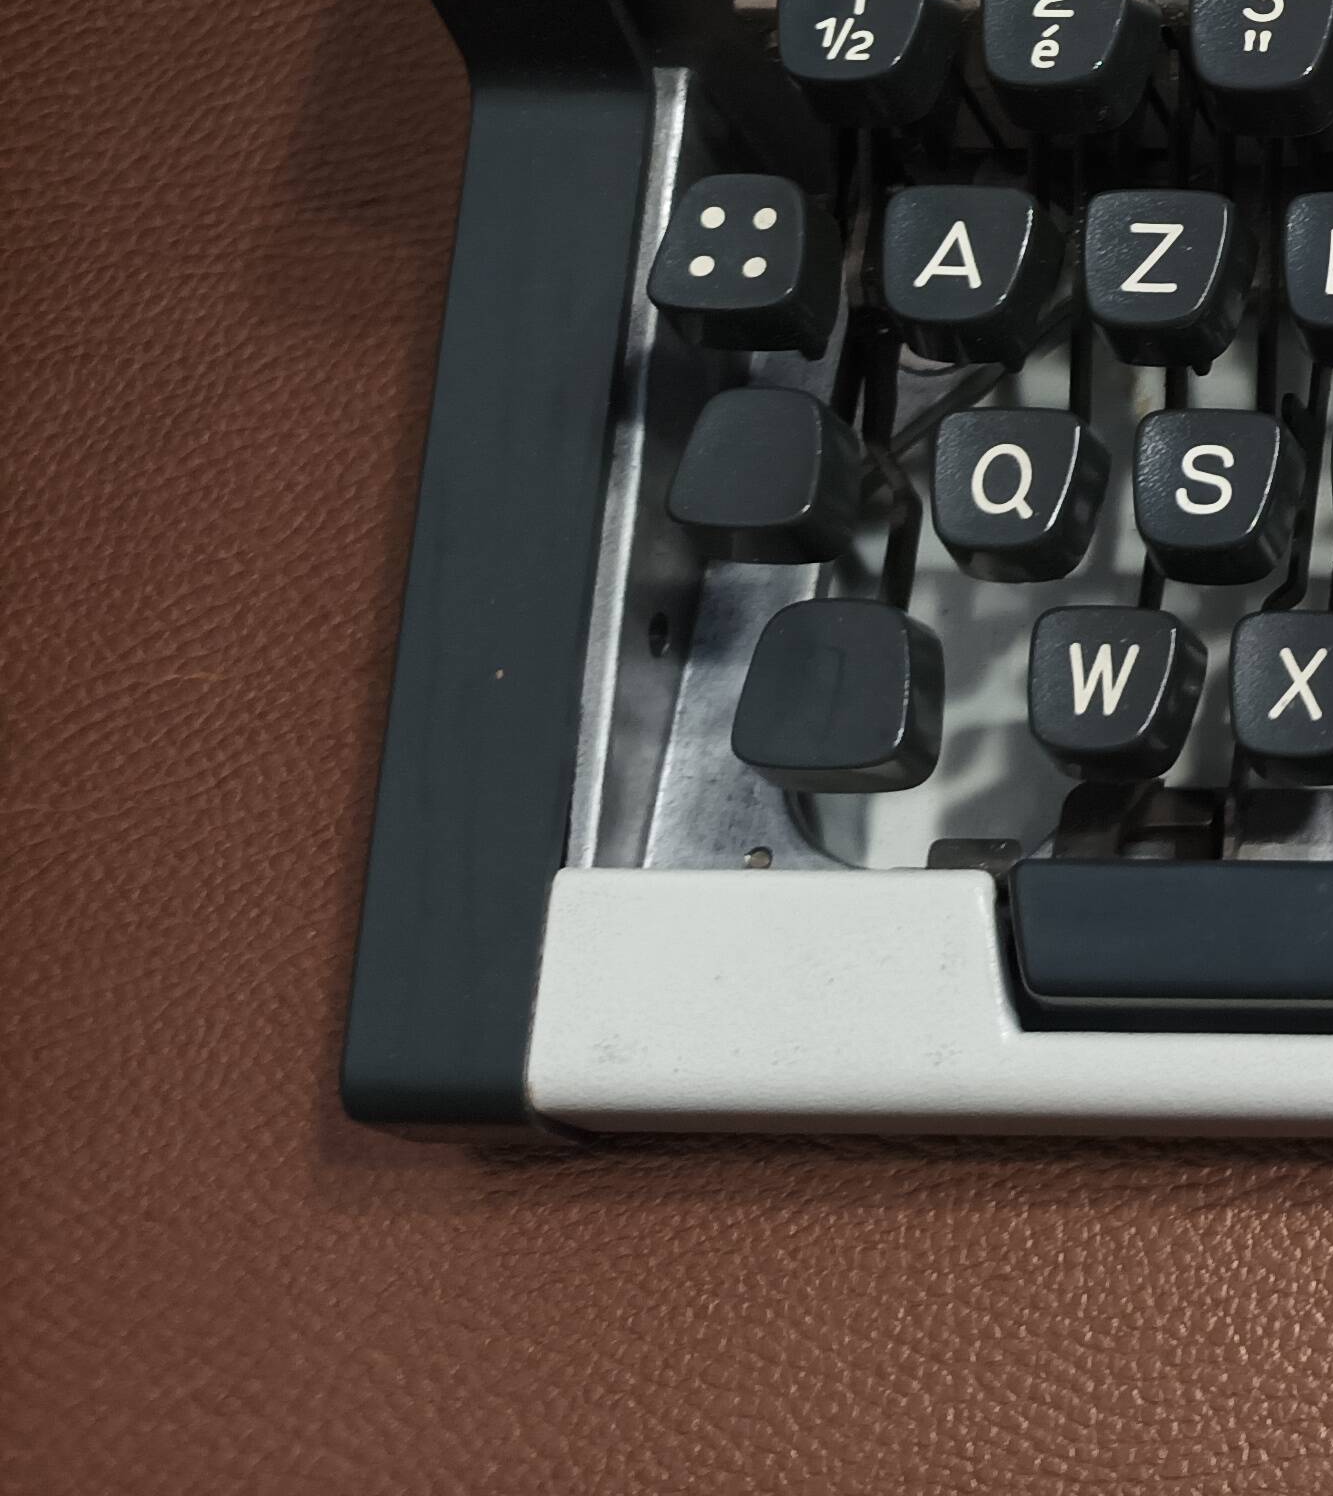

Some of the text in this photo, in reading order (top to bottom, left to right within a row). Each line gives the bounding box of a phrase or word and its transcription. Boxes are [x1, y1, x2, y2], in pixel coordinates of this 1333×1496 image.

[1030, 23, 1060, 69] é
[913, 220, 982, 289] A
[1120, 222, 1182, 294] Z
[971, 443, 1033, 519] Q
[1175, 444, 1235, 515] S
[1069, 642, 1140, 716] W
[1268, 647, 1328, 721] X
